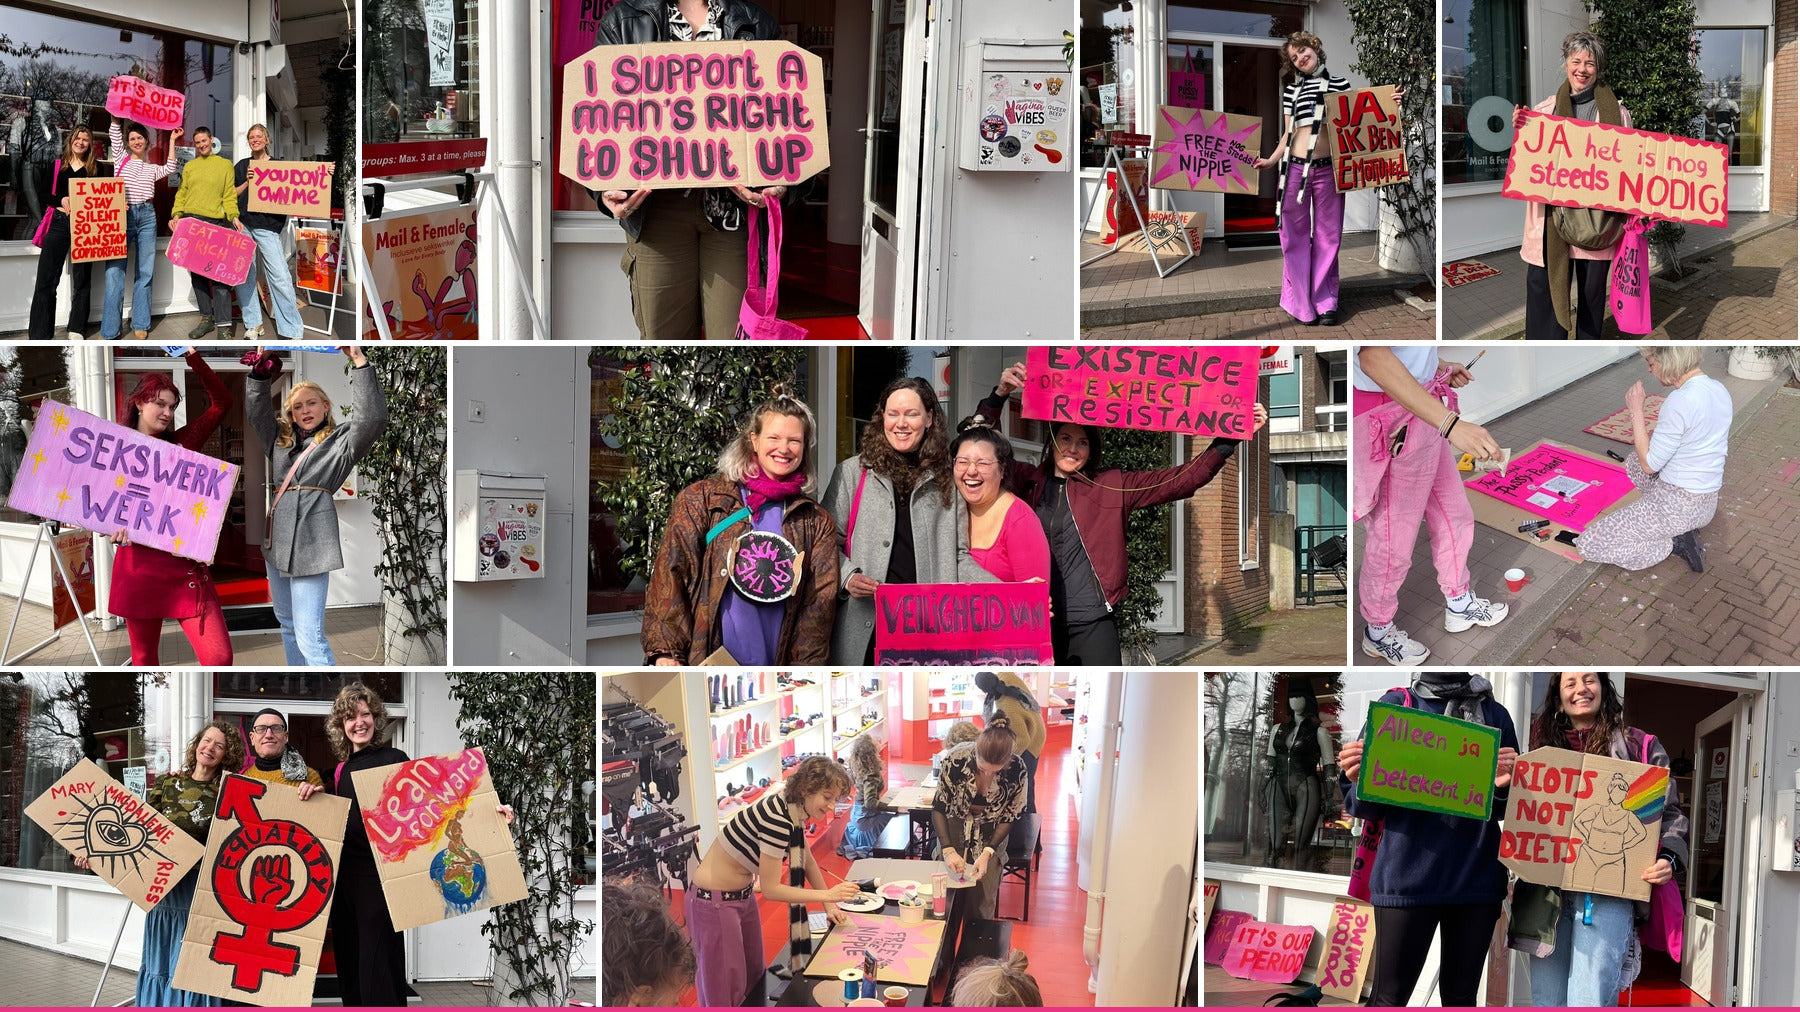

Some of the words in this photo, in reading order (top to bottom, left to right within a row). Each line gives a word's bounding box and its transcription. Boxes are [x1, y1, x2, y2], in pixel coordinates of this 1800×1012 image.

[584, 60, 597, 97] I
[777, 51, 808, 91] A
[112, 80, 145, 98] IT'S
[151, 91, 182, 108] OUR
[120, 96, 180, 124] PERIOD
[1016, 111, 1045, 125] VIBES
[1184, 134, 1226, 153] FREE
[1367, 125, 1401, 152] BEN
[1524, 121, 1572, 158] JA
[1585, 133, 1623, 163] het
[1636, 144, 1657, 168] is
[1667, 155, 1708, 179] nog
[399, 154, 418, 164] Max.
[420, 153, 426, 162] 3
[427, 152, 435, 161] at
[443, 151, 461, 161] time,
[463, 150, 486, 160] please
[756, 134, 813, 182] UP
[1179, 154, 1232, 179] NIPPLE
[1198, 150, 1217, 160] THE
[1470, 156, 1488, 166] Mail
[1489, 155, 1496, 165] &
[76, 182, 86, 195] I
[254, 167, 289, 186] YOU
[1529, 160, 1610, 191] steeds
[1618, 170, 1720, 215] NODIG
[84, 196, 113, 210] STAY
[258, 186, 290, 205] OWN
[74, 223, 91, 235] SO
[97, 222, 120, 234] YOU
[75, 209, 120, 223] SILENT
[74, 235, 101, 247] CAN
[101, 233, 127, 246] STAY
[188, 223, 218, 240] EAT
[225, 233, 251, 250] THE
[375, 227, 407, 251] Mail
[410, 226, 420, 244] &
[422, 217, 466, 241] Female
[1189, 226, 1201, 252] RISES
[203, 261, 213, 273] &
[1624, 246, 1638, 265] EAT
[1263, 359, 1289, 371] FEMALE
[1085, 377, 1202, 407] EXPECT
[62, 426, 229, 501] SEKSWERK
[81, 484, 182, 537] WERK
[506, 530, 527, 541] VIBES
[1008, 598, 1044, 633] VAN
[1376, 714, 1447, 752] Alleen
[1458, 737, 1480, 758] ja
[50, 781, 96, 800] MARY
[1371, 758, 1459, 801] betekent
[1463, 784, 1484, 808] ja
[1512, 760, 1598, 800] RIOTS
[367, 760, 440, 843] Lean
[409, 750, 482, 840] forward
[105, 785, 175, 845] MAGDALENE
[1515, 799, 1574, 827] NOT
[1499, 830, 1583, 864] DIETS
[145, 861, 175, 905] RISES
[841, 926, 881, 957] NIPPLE
[878, 932, 907, 957] FREE
[1237, 927, 1277, 948] IT'S
[1282, 932, 1312, 951] OUR
[1239, 948, 1304, 974] PERIOD
[1319, 947, 1342, 990] YOU
